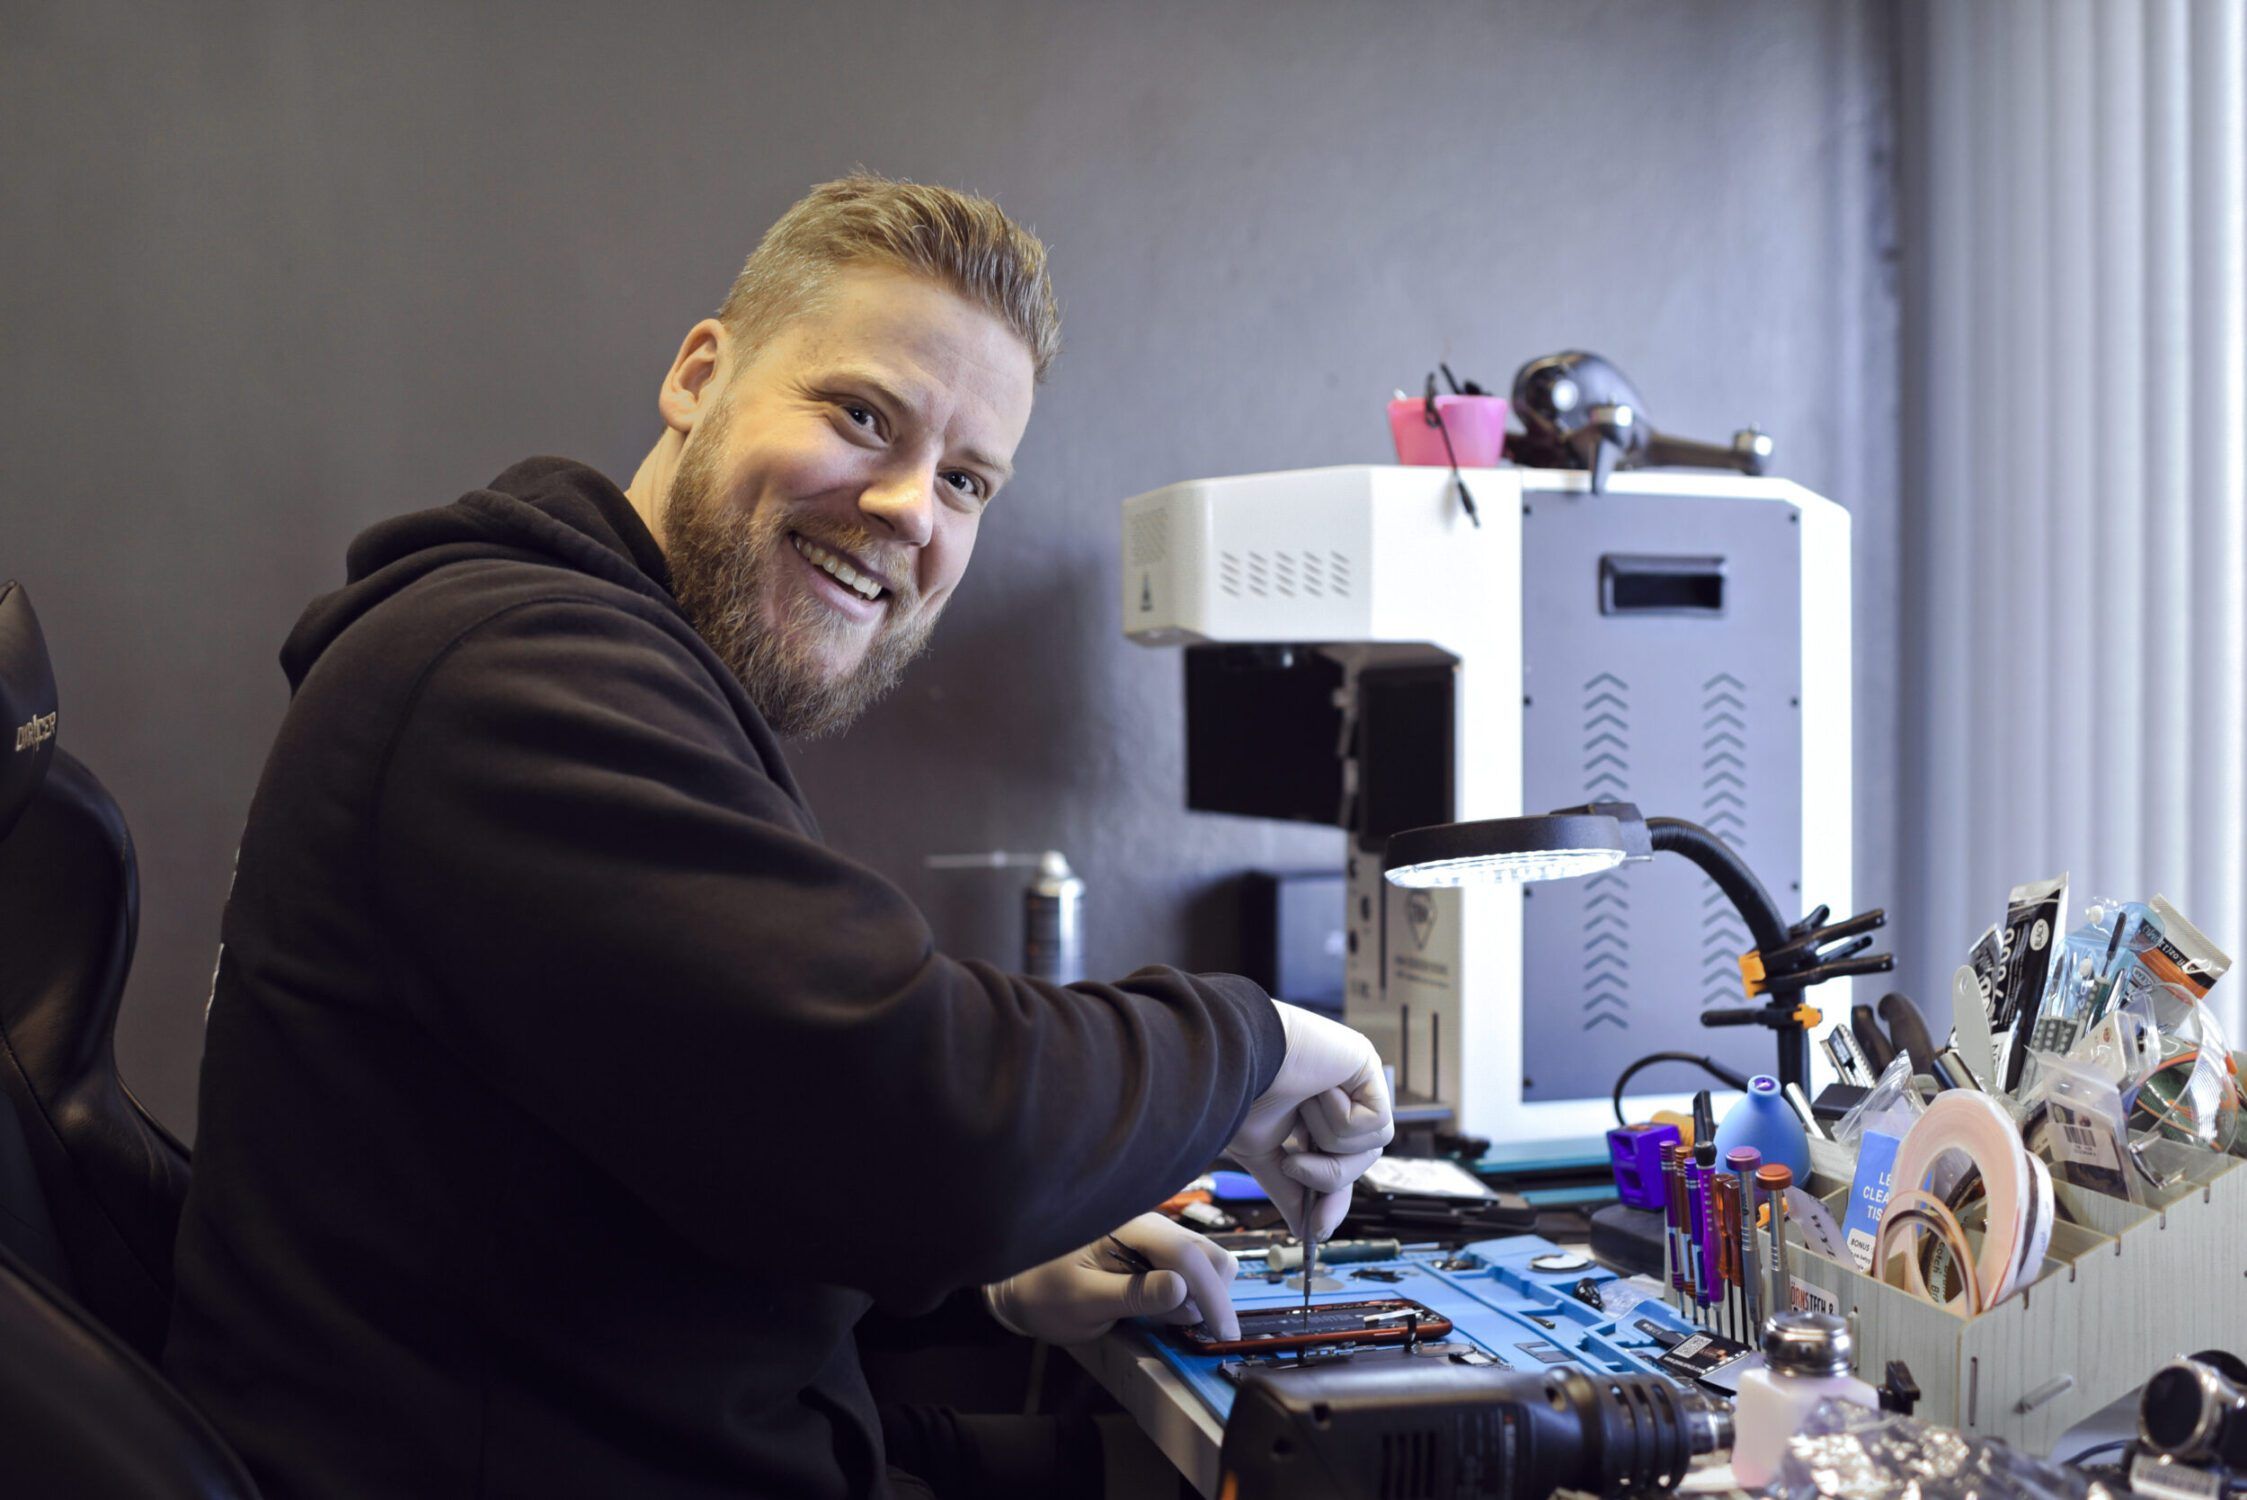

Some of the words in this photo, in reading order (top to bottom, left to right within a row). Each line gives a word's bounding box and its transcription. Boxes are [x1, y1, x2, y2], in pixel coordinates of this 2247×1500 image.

[2034, 923, 2045, 948] BLACK
[1879, 1171, 1891, 1186] LE
[1862, 1186, 1889, 1204] CLEA
[1867, 1205, 1883, 1222] TIS
[1933, 1241, 1945, 1273] cotch
